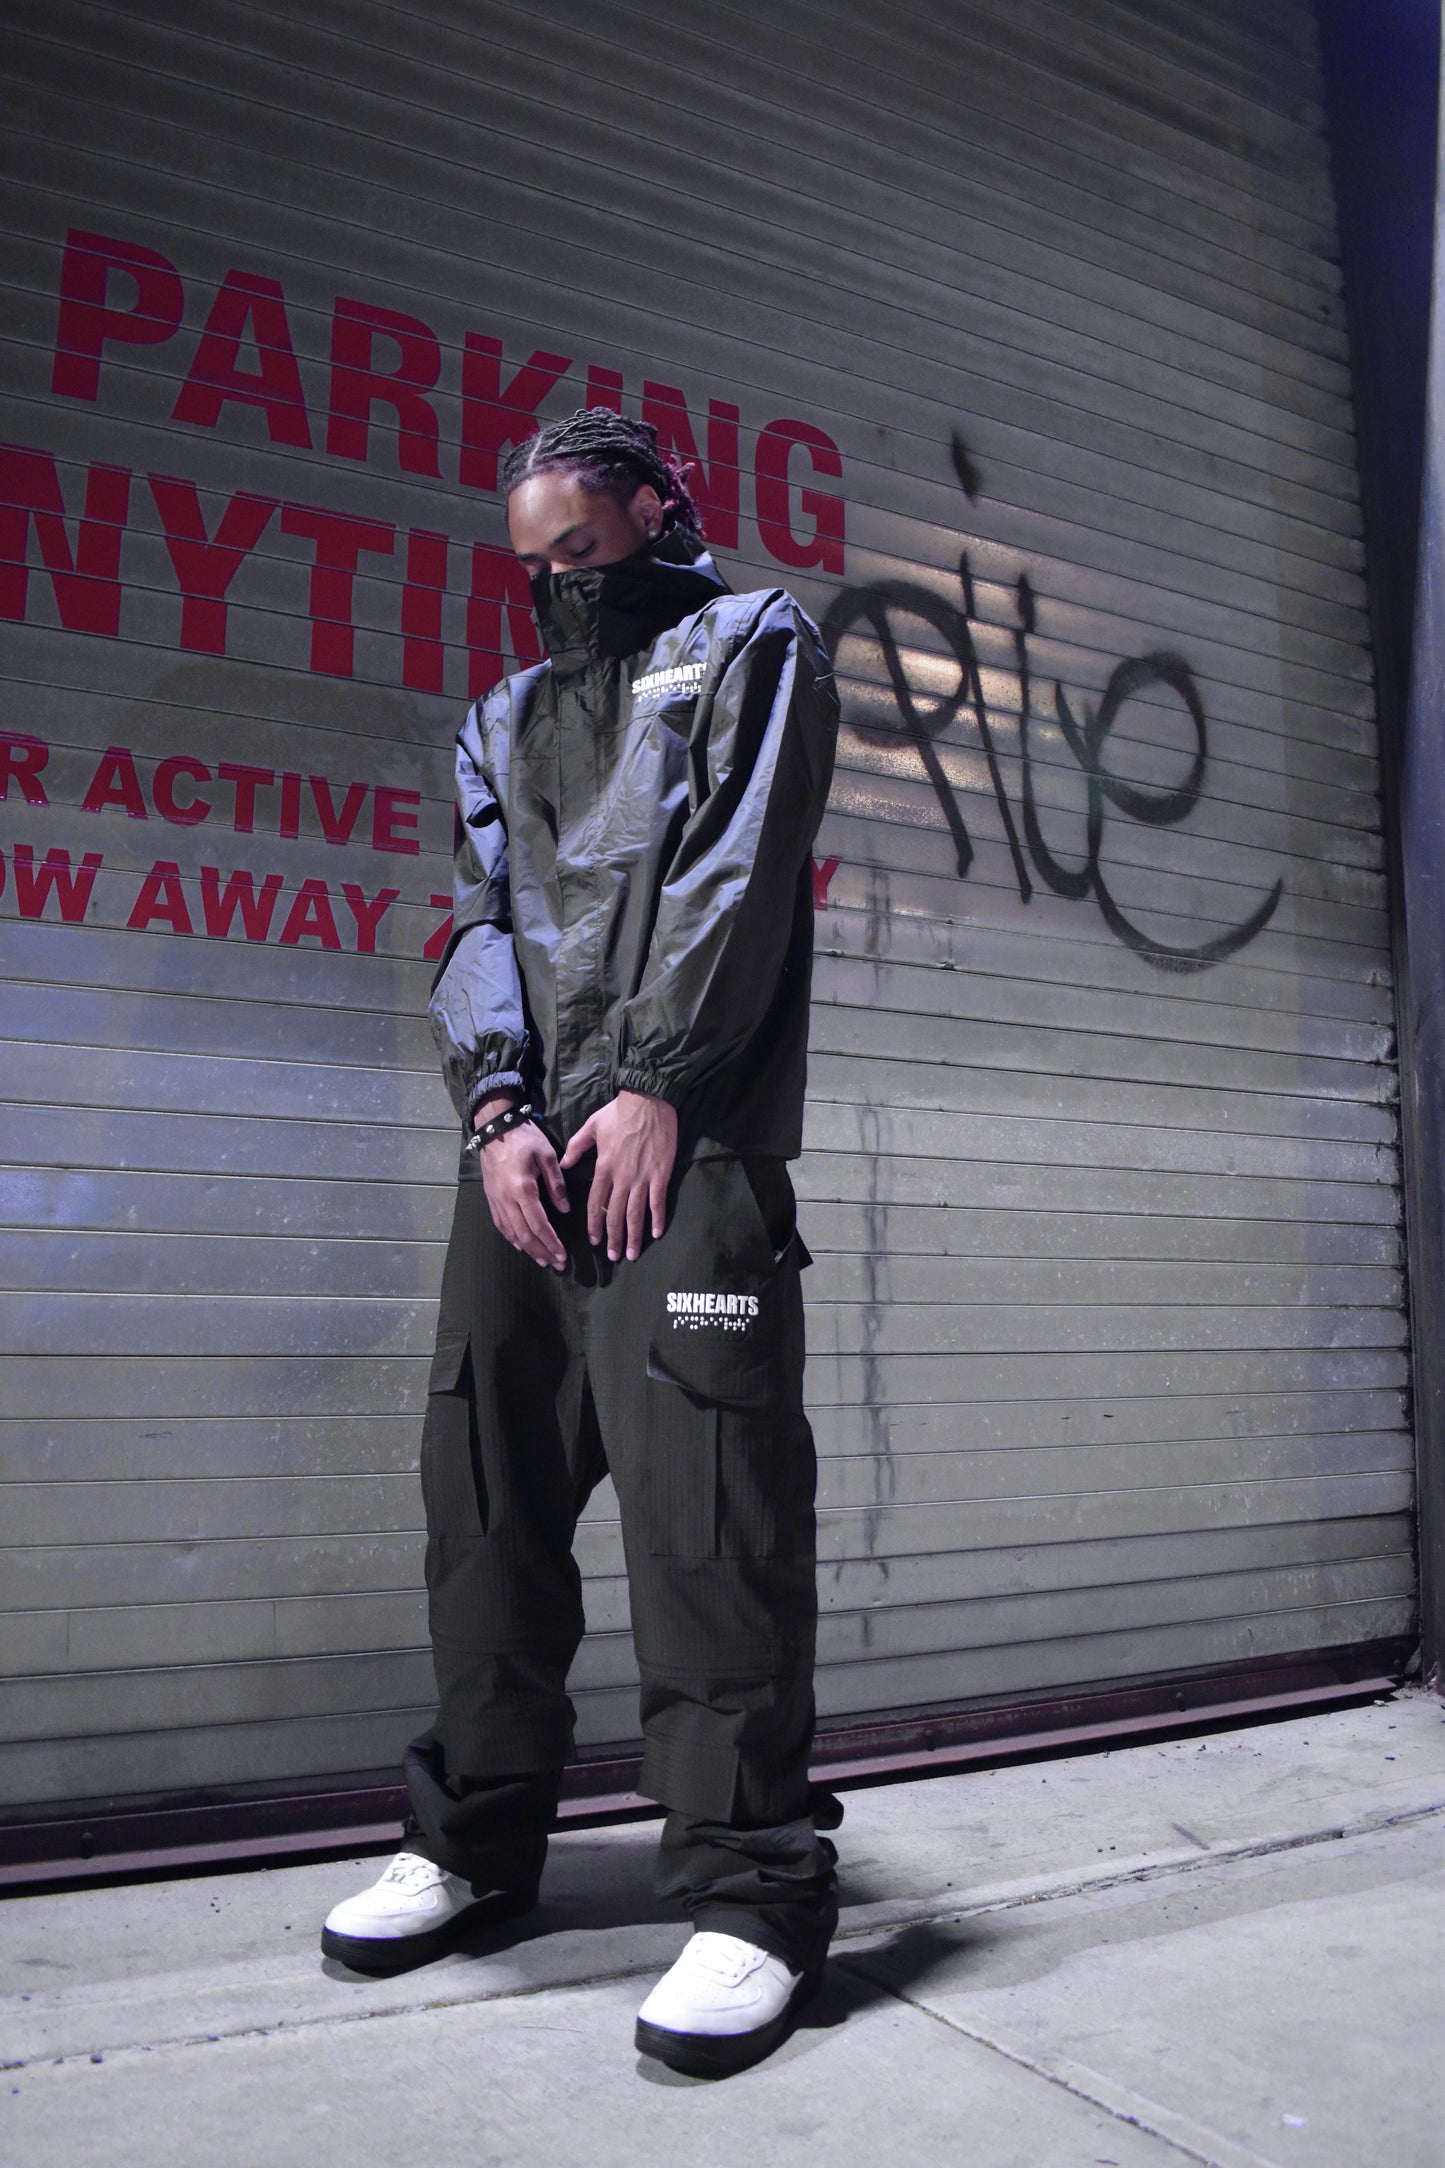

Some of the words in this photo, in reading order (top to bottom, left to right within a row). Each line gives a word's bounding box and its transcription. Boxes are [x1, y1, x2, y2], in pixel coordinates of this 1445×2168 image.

[52, 228, 845, 576] PARKNG
[80, 745, 421, 856] ACTIVE
[0, 843, 104, 922] W
[126, 860, 401, 953] AWAY
[666, 1292, 759, 1316] SIXHEARTS
